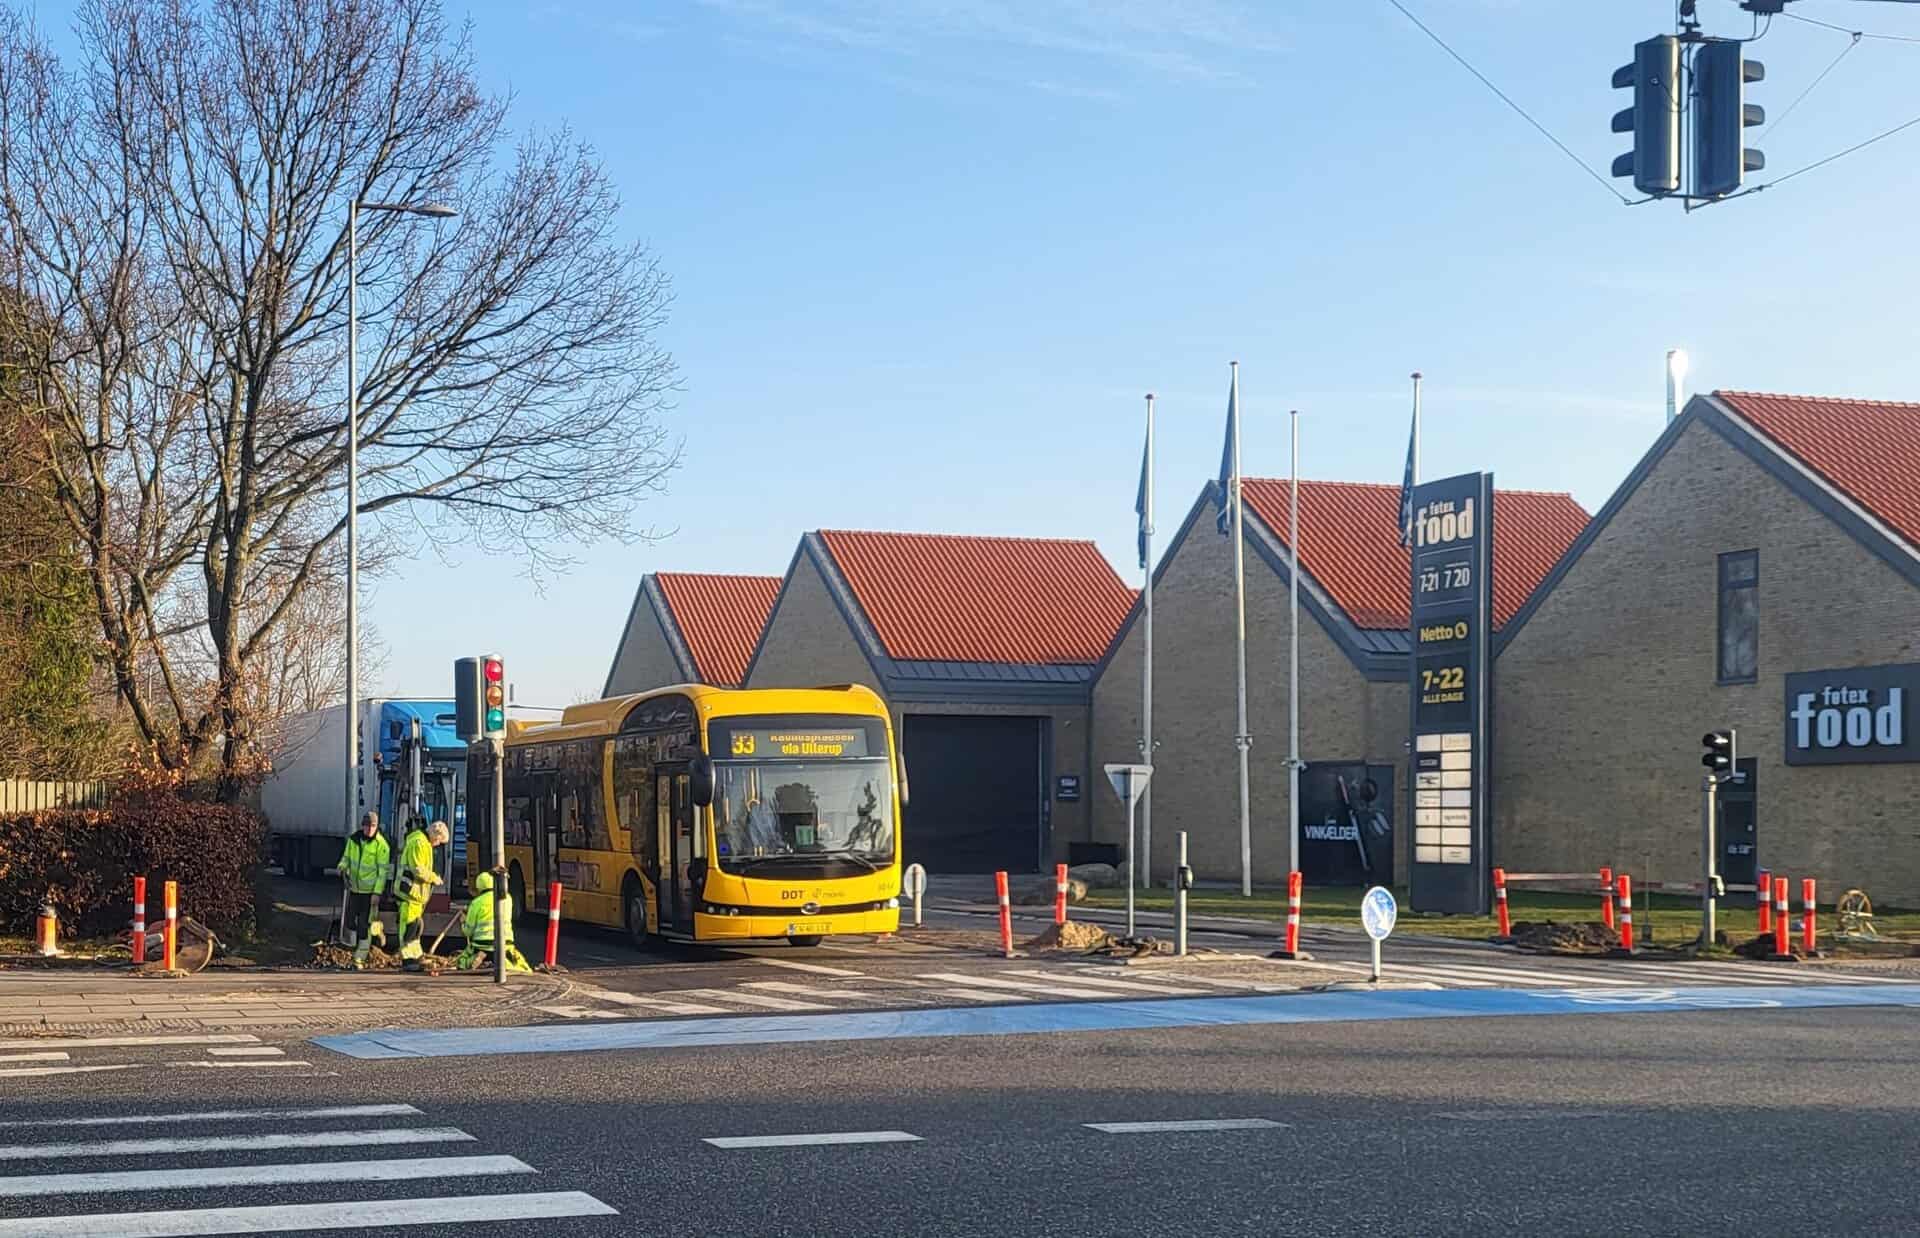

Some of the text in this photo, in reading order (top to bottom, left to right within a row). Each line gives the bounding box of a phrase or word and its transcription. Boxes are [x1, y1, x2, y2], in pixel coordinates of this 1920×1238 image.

[1416, 498, 1474, 547] food
[1420, 625, 1453, 642] Netto
[1422, 667, 1464, 691] 7-22
[1791, 688, 1902, 748] food
